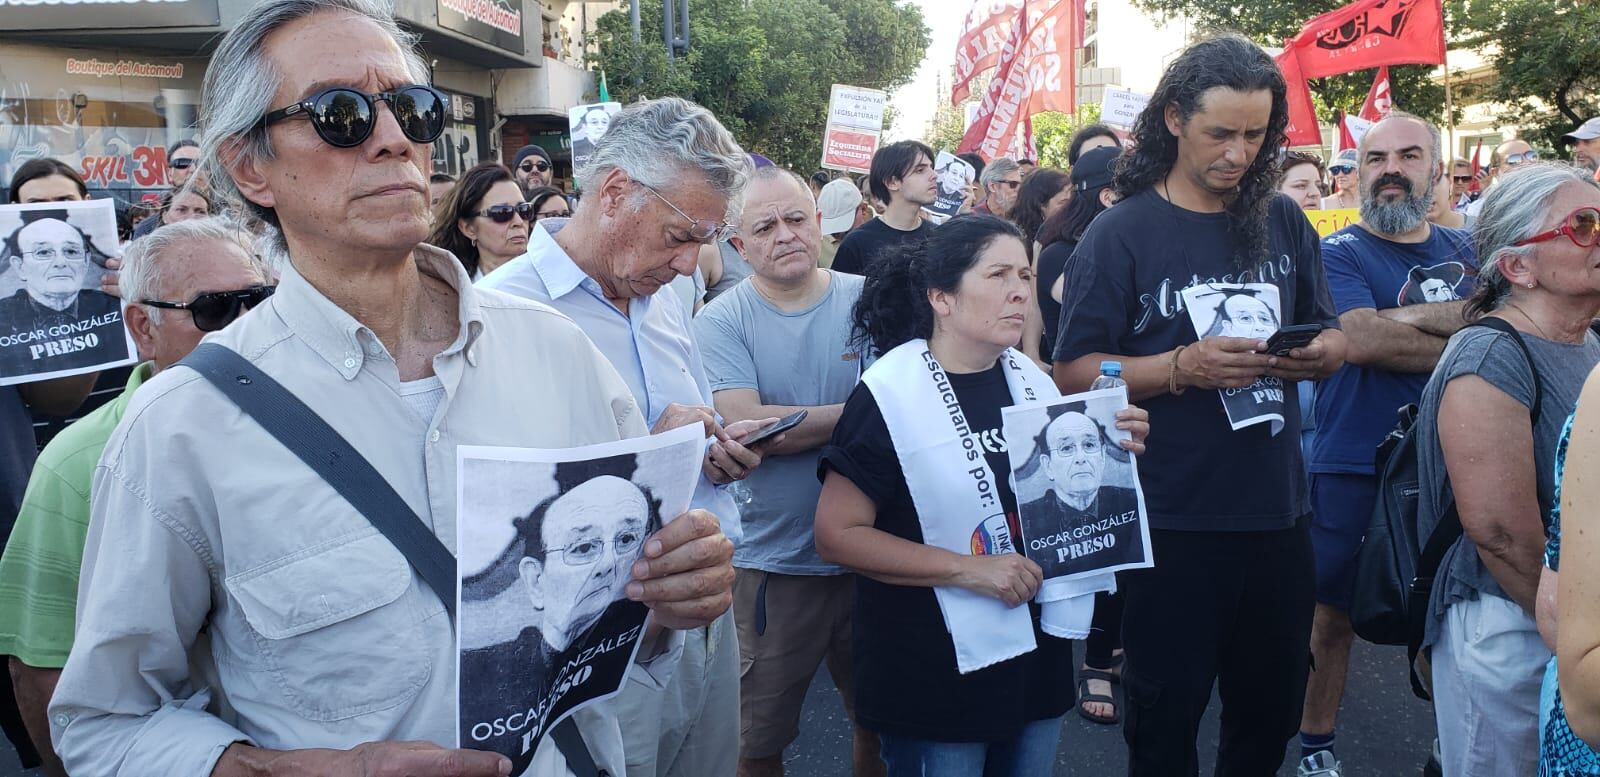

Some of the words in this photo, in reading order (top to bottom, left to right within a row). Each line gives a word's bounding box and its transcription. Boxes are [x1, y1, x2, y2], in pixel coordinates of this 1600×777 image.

[66, 58, 115, 77] Boutique
[115, 61, 133, 75] del
[132, 63, 183, 78] Automovil
[80, 156, 128, 187] SKIL
[132, 145, 173, 187] 3M
[0, 329, 47, 347] OSCAR
[48, 311, 120, 338] GONZÁLEZ
[29, 332, 99, 361] PRESO
[968, 466, 995, 508] por:
[1030, 530, 1070, 552] OSCAR
[1072, 510, 1138, 540] GONZÁLEZ
[1056, 532, 1117, 564] PRESO
[548, 624, 641, 699] ONZÁLEZ
